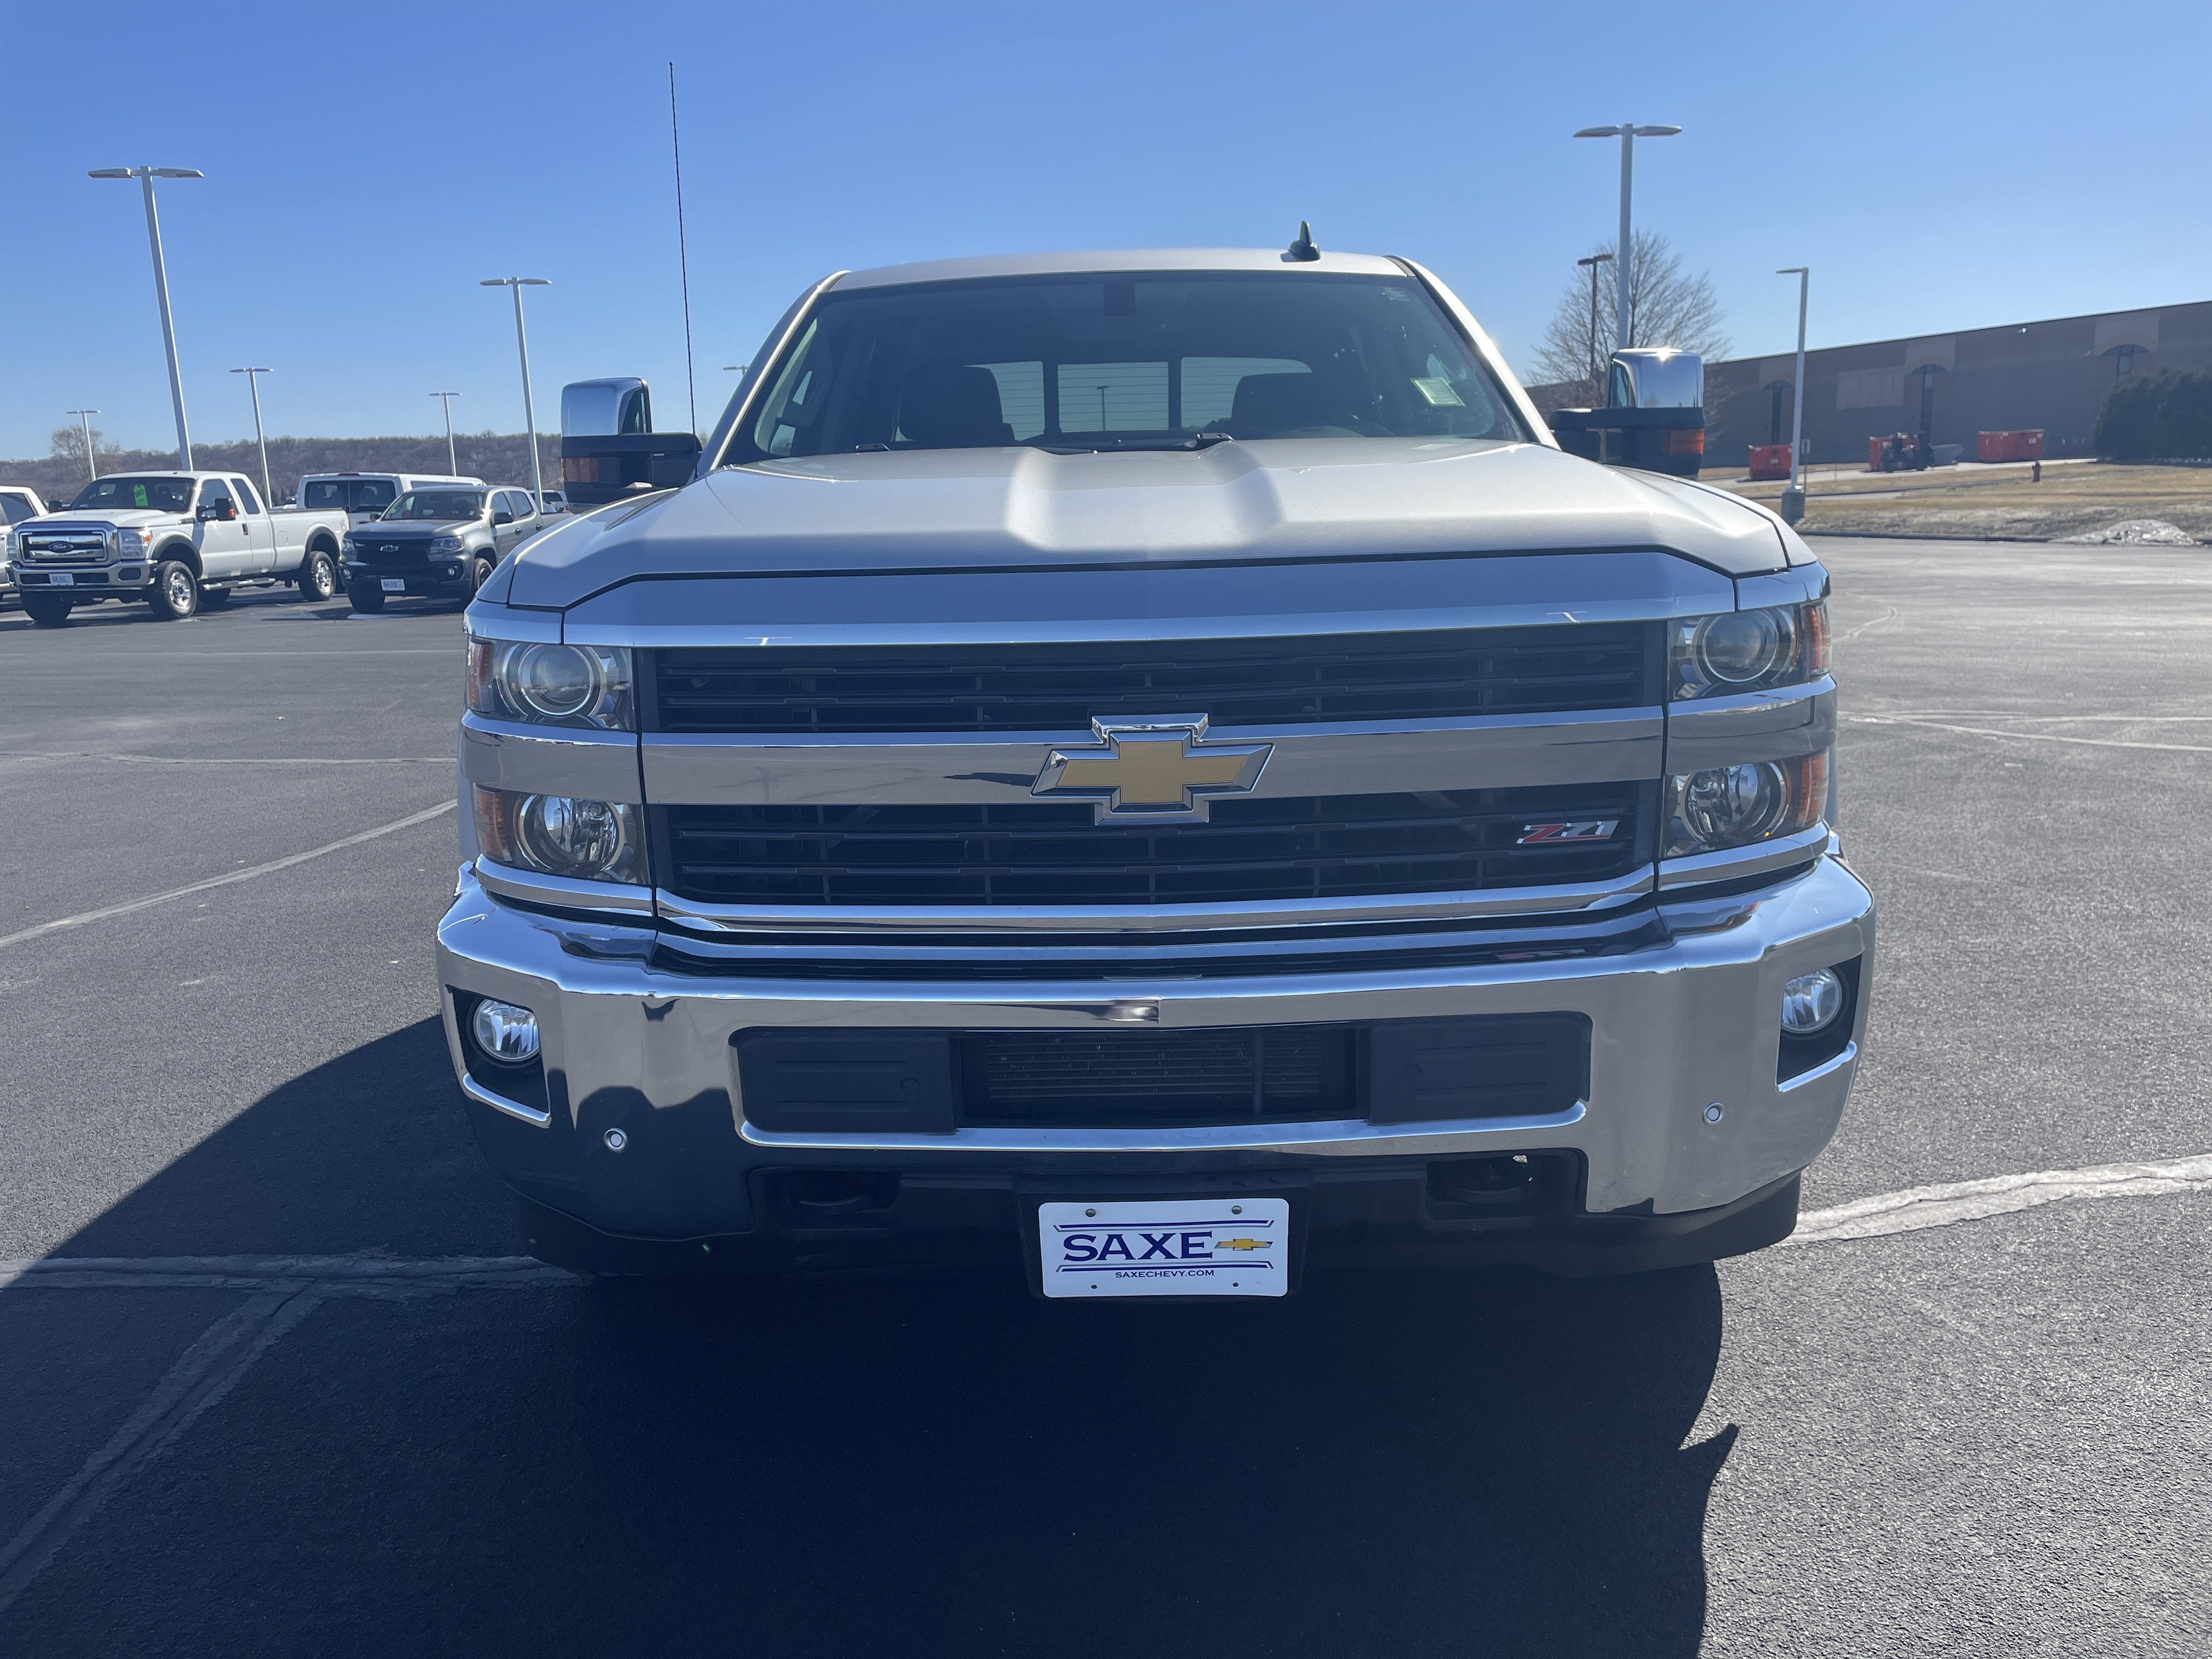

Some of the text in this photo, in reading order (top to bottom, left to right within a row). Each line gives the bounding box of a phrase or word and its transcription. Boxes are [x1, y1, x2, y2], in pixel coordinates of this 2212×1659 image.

[1516, 820, 1619, 844] Z71
[1063, 1231, 1213, 1262] SAXE
[1115, 1269, 1215, 1278] SAXECHEVY.COM
